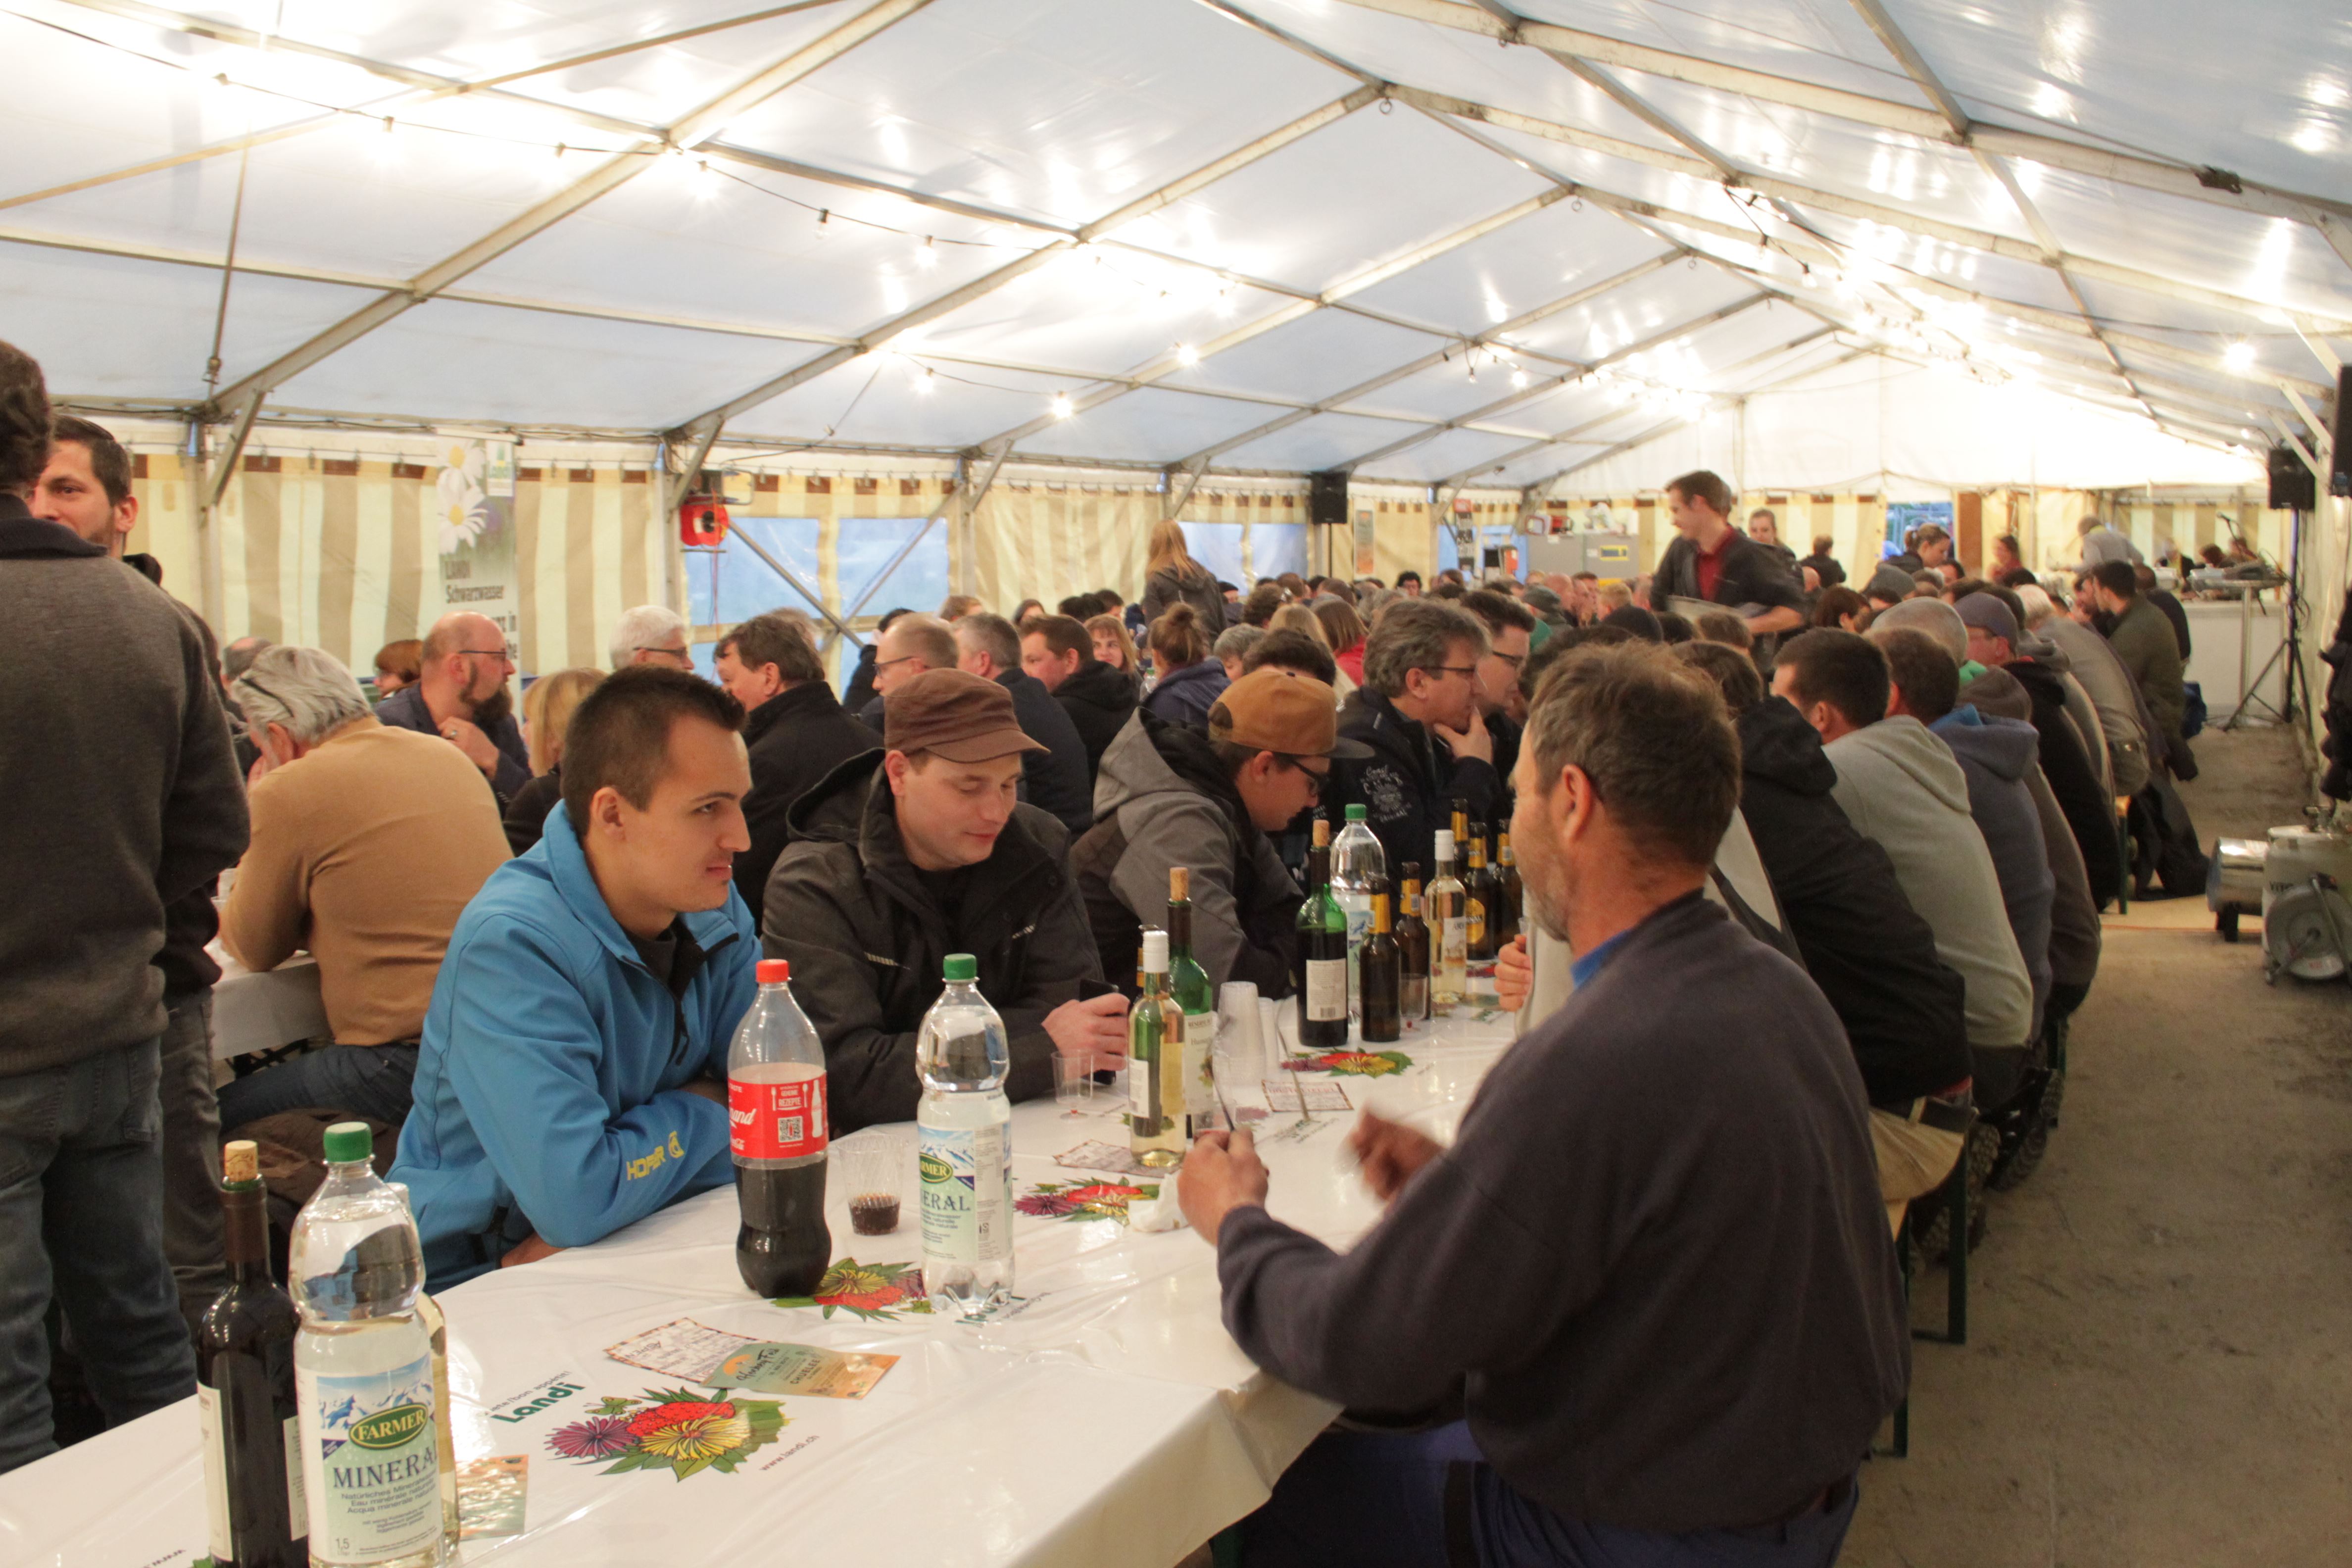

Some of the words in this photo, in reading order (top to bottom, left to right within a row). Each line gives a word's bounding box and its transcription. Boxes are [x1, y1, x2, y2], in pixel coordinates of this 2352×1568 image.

[921, 1189, 971, 1211] ERAL
[625, 1341, 662, 1359] ASPEN
[490, 1382, 586, 1423] Landi
[357, 1410, 424, 1440] FARMER
[759, 1435, 820, 1470] www.landi.ch
[335, 1538, 350, 1551] 1,5
